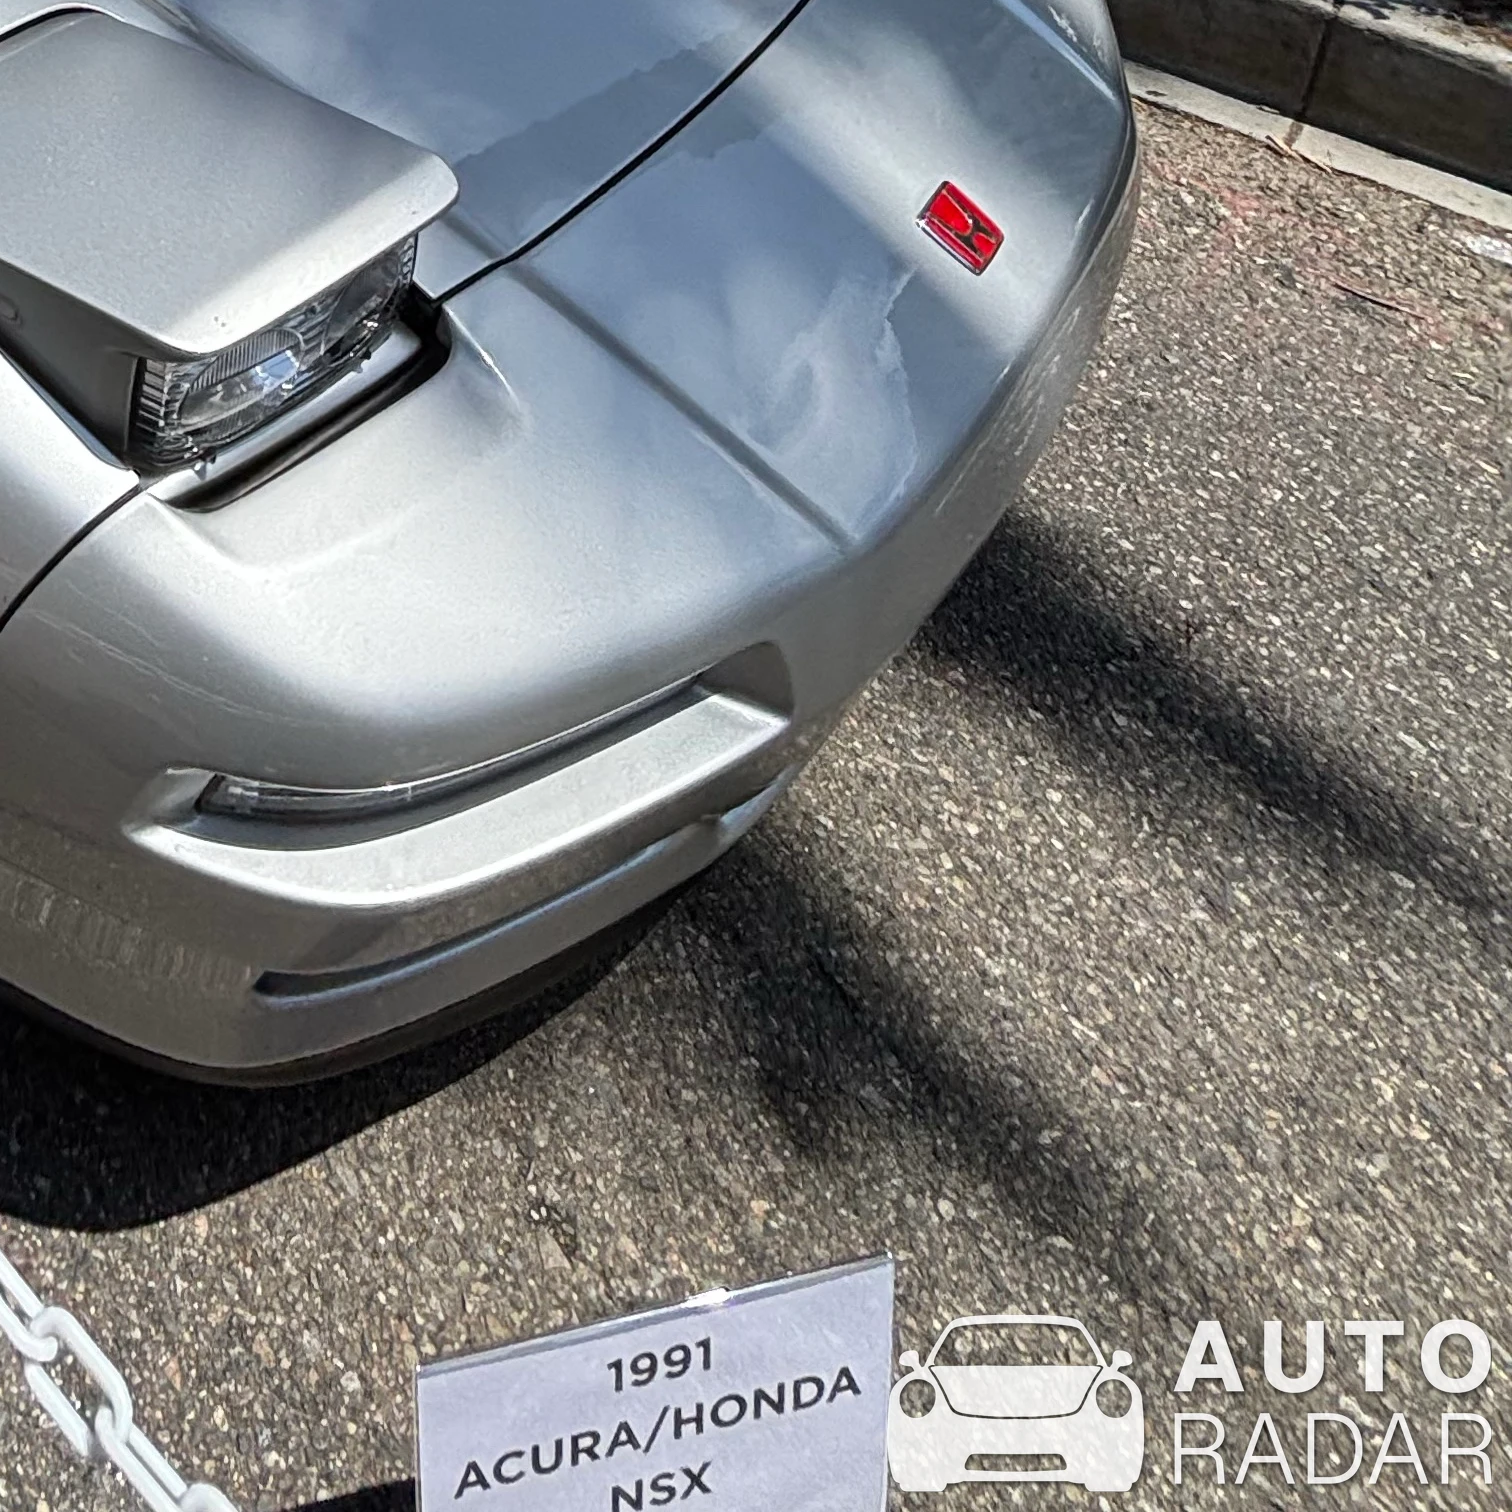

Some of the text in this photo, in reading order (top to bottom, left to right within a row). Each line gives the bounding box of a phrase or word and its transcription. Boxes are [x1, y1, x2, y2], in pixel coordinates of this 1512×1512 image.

[606, 1336, 712, 1393] 1991
[453, 1366, 863, 1500] ACURA/HONDA
[611, 1460, 713, 1512] NSX
